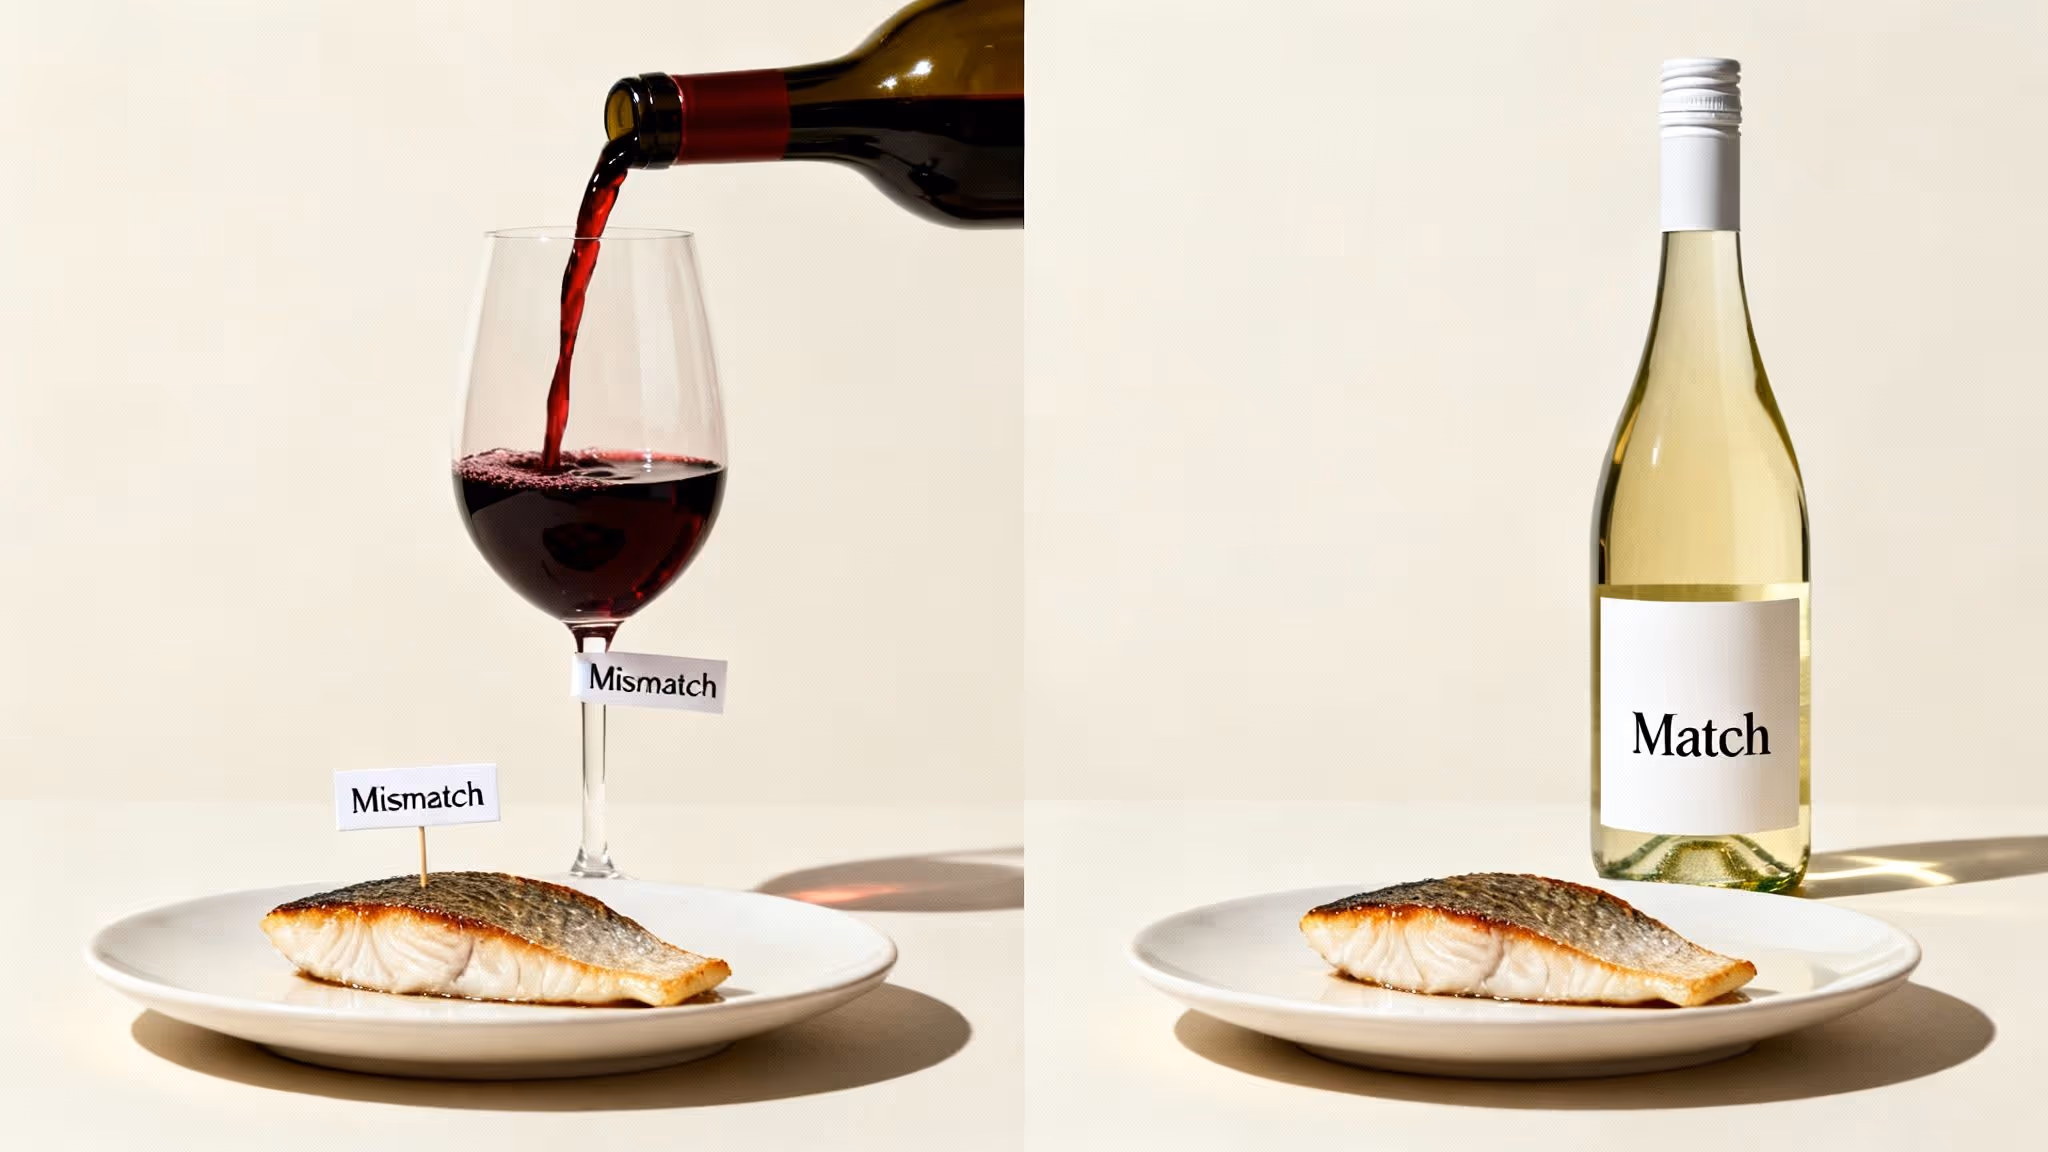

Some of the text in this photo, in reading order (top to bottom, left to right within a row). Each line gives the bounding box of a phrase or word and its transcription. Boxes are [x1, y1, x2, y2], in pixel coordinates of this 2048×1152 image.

[589, 663, 717, 698] Mismatch
[1632, 711, 1772, 758] Match
[351, 781, 485, 813] Mismatch
